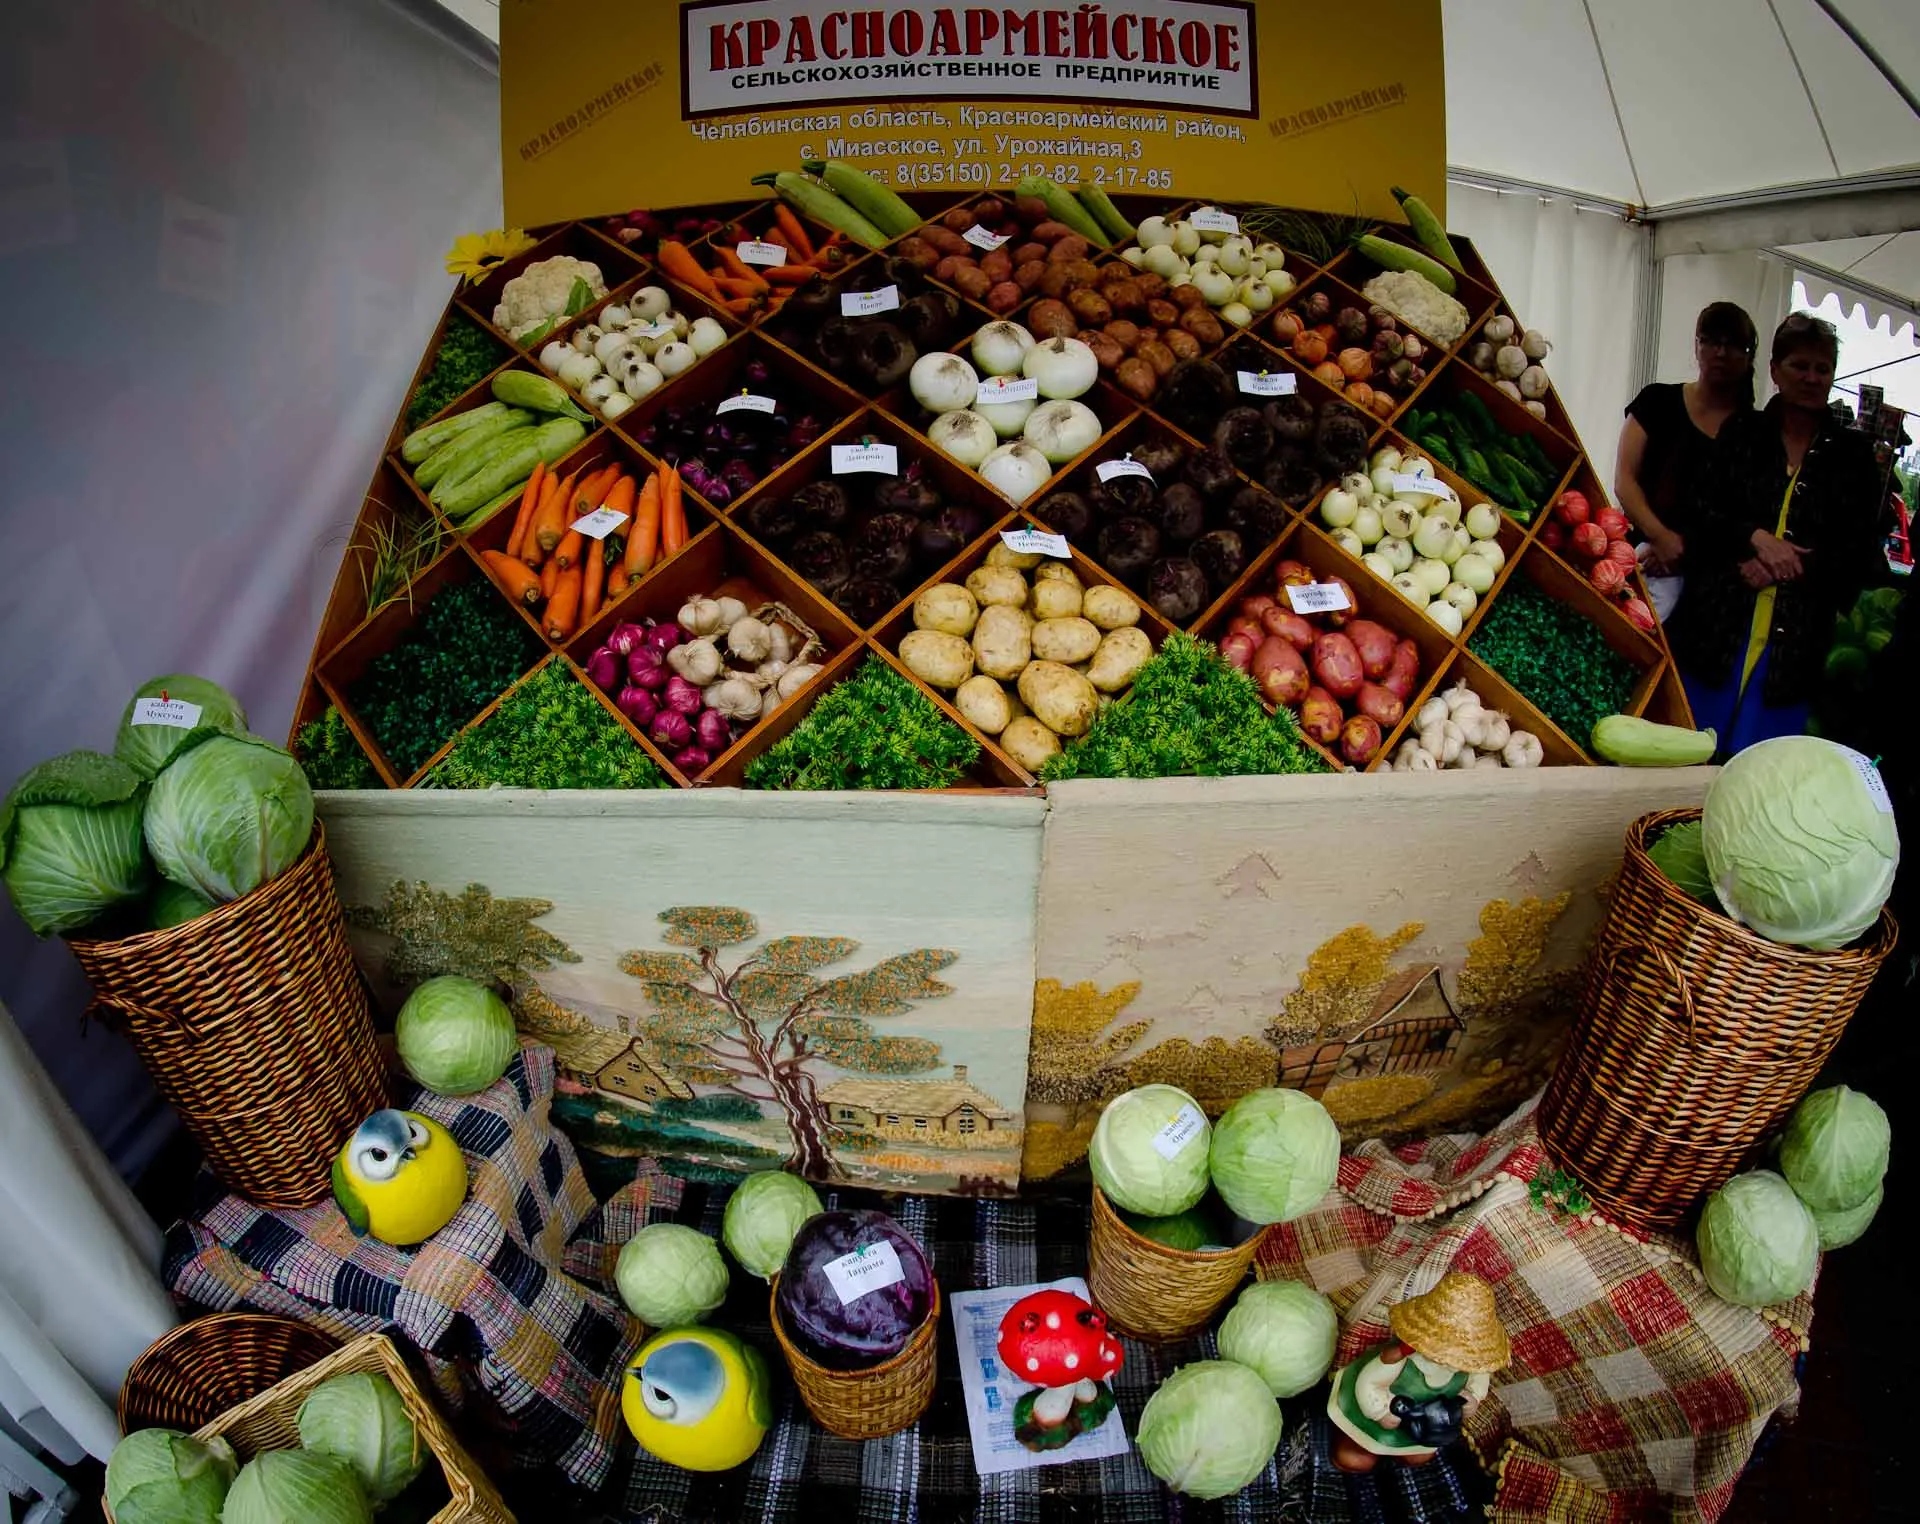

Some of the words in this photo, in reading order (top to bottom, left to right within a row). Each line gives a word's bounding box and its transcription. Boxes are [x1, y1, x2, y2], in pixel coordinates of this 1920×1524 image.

[709, 3, 1240, 72] КРАСНОАРМЕЙСКОЕ
[731, 61, 1041, 89] СЕЛЬСКОХОЗЯЙСТВЕННОЕ
[1056, 64, 1220, 90] ПРЕДПРИЯТИЕ
[519, 61, 665, 162] КРАСНОАРМЕЙСКОЕ
[691, 115, 841, 142] Челябинская
[849, 107, 952, 128] область,
[960, 105, 1168, 133] Красноармейский
[1175, 117, 1247, 143] район,
[1268, 81, 1408, 138] КРАСНОАРМЕЙСКОЕ
[800, 144, 819, 160] с.
[826, 137, 945, 158] Миасское,
[953, 138, 988, 158] ул.
[994, 134, 1142, 161] Урожайная,3
[895, 162, 992, 188] 8(35150)
[1094, 166, 1173, 189] 2-17-85
